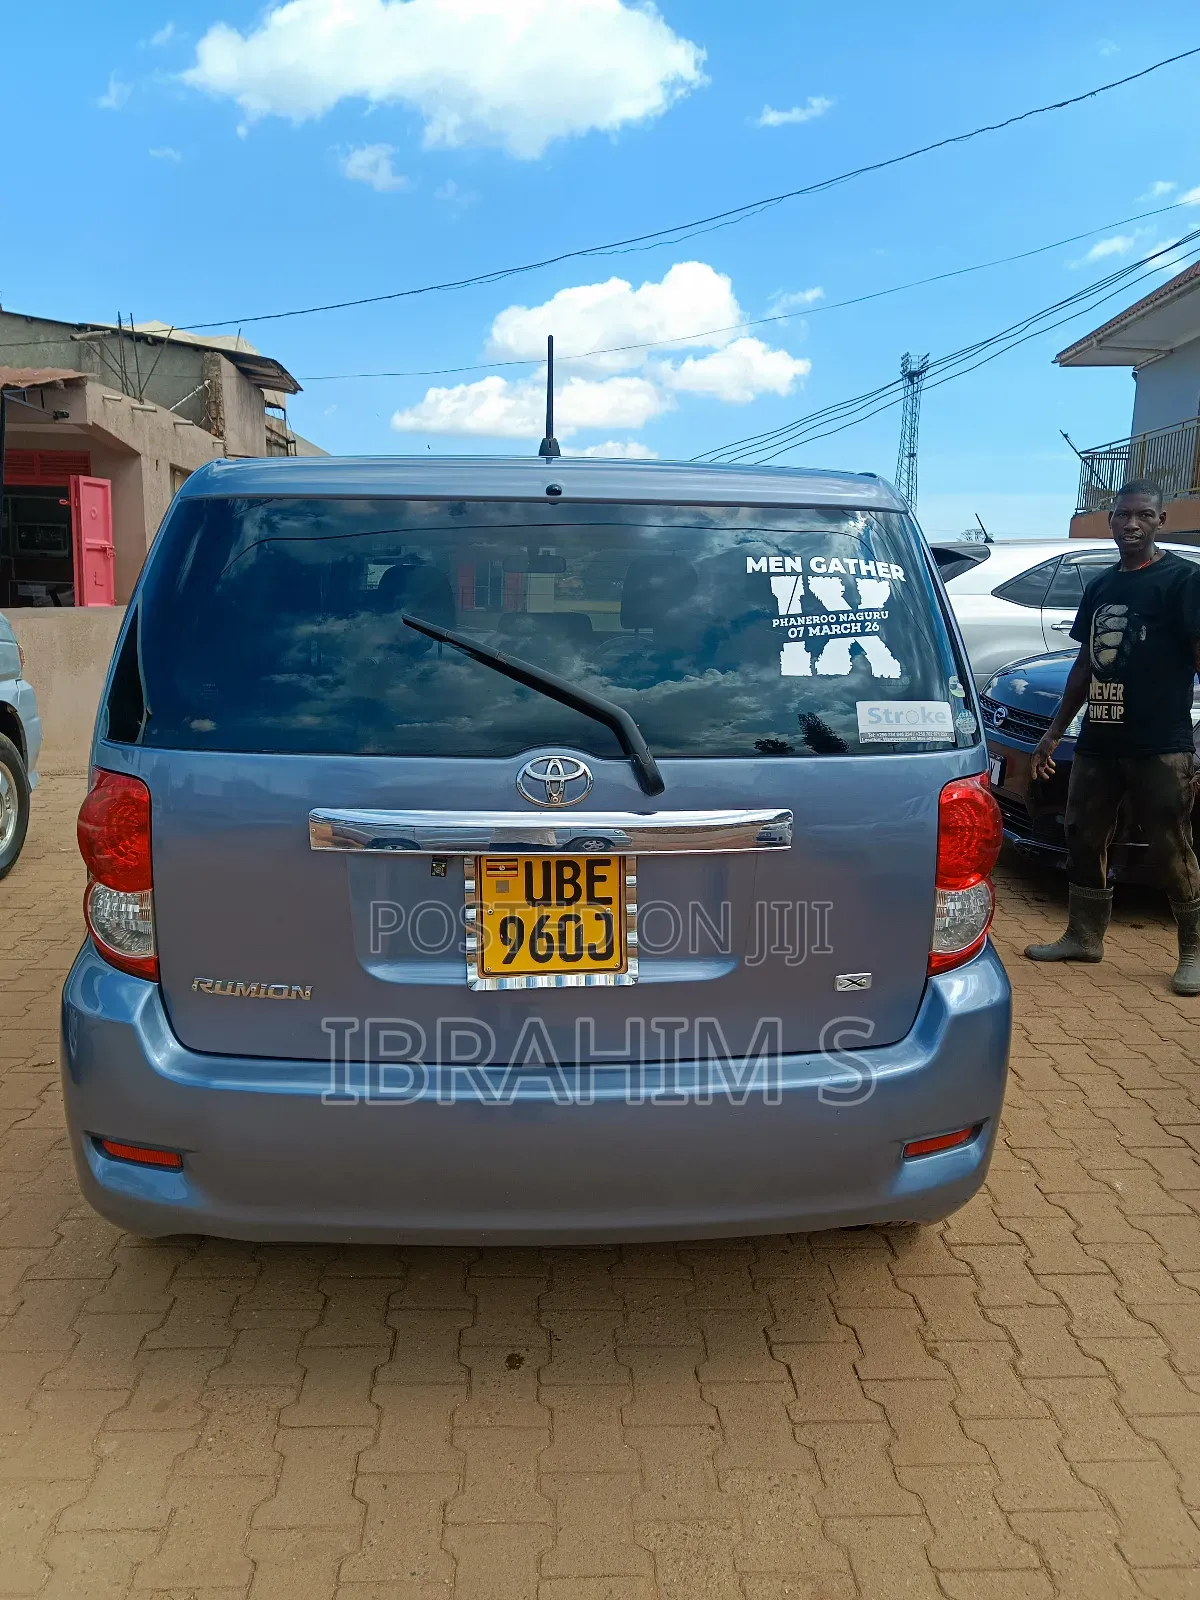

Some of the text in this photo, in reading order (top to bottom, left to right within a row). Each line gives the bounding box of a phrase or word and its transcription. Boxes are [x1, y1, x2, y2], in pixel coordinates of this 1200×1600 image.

[746, 556, 907, 582] MEN GATHER
[772, 610, 889, 628] PHANEROO NAGURU
[787, 621, 880, 639] 07 MARCH 26
[1089, 682, 1124, 701] NEVER
[867, 706, 948, 725] Stroke
[1088, 704, 1125, 720] GIVE UP
[524, 858, 613, 908] UBE
[499, 912, 615, 965] 960J
[191, 975, 314, 1001] RUMION
